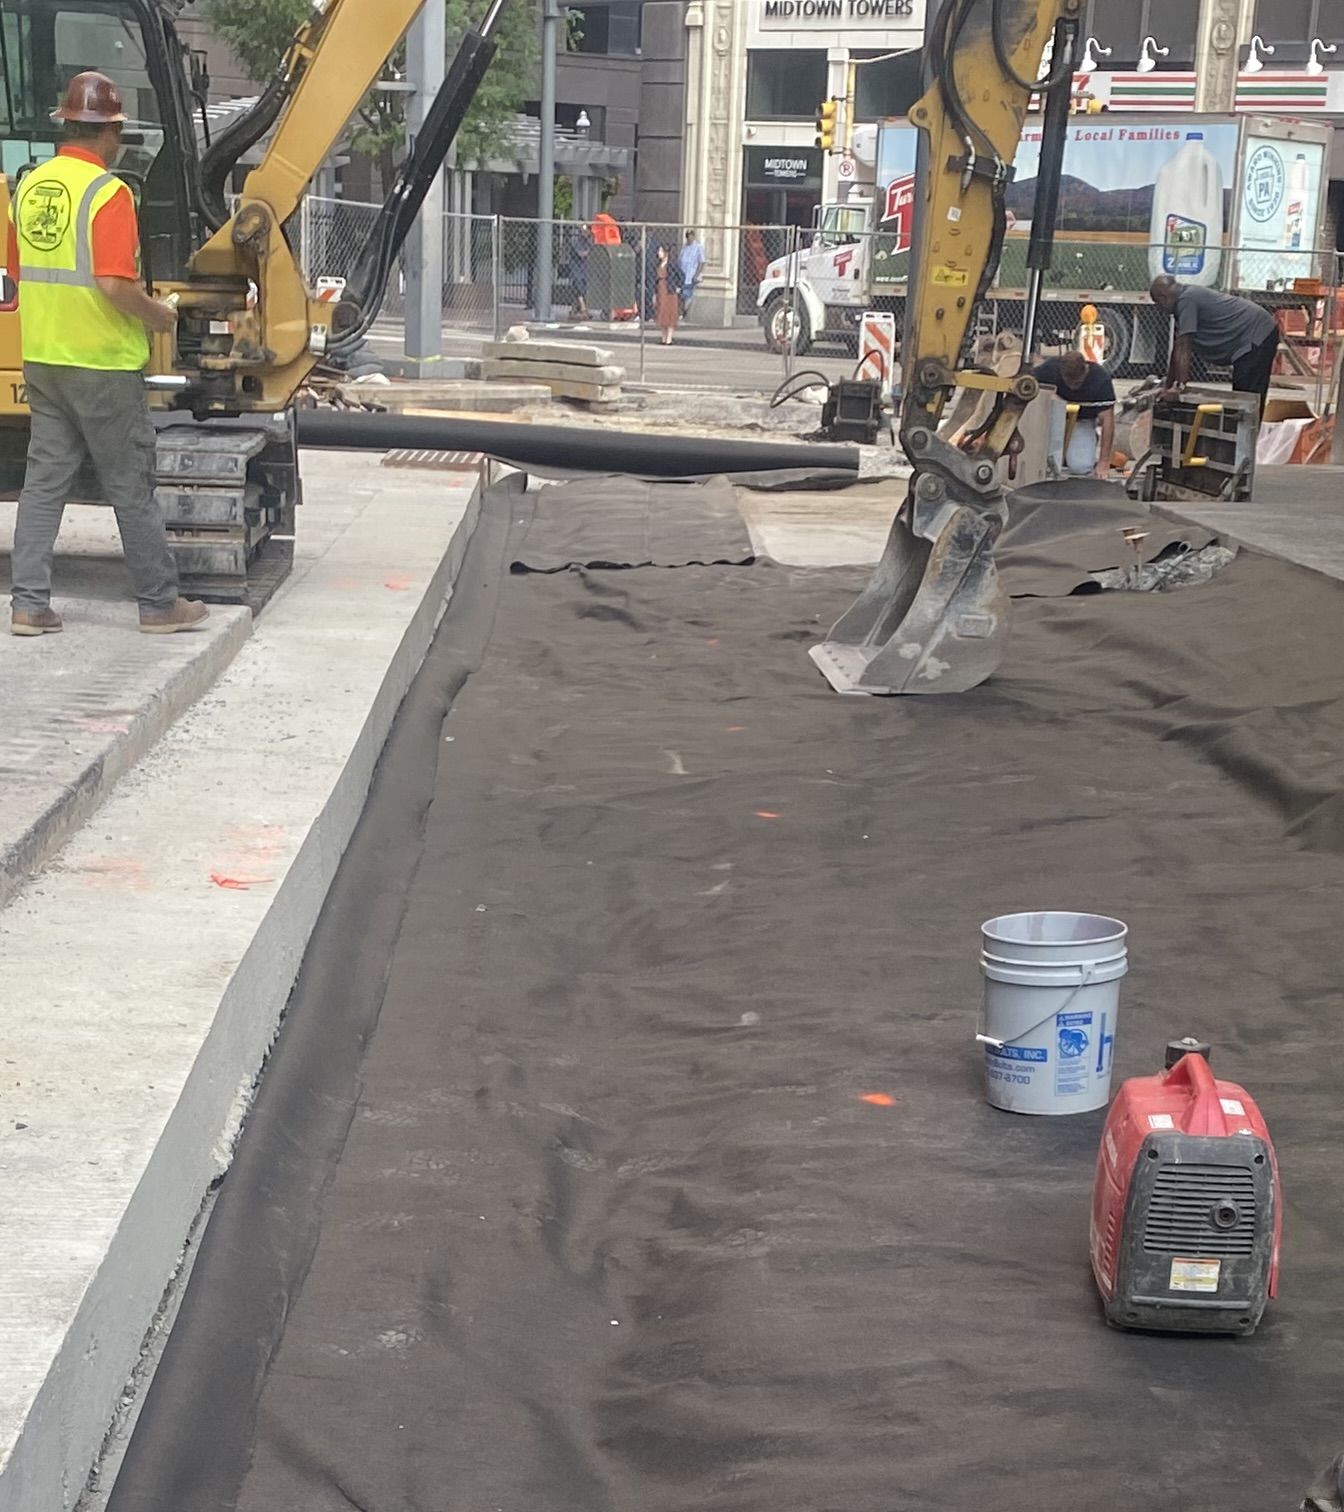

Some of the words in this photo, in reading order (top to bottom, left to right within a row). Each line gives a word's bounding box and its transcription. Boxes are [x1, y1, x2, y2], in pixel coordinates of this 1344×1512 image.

[765, 0, 842, 17] MIDTOWN
[848, 0, 914, 16] TOWERS
[1074, 128, 1113, 141] Local
[1118, 128, 1181, 141] Families
[764, 158, 807, 170] MIDTOWN
[1258, 181, 1270, 198] PA
